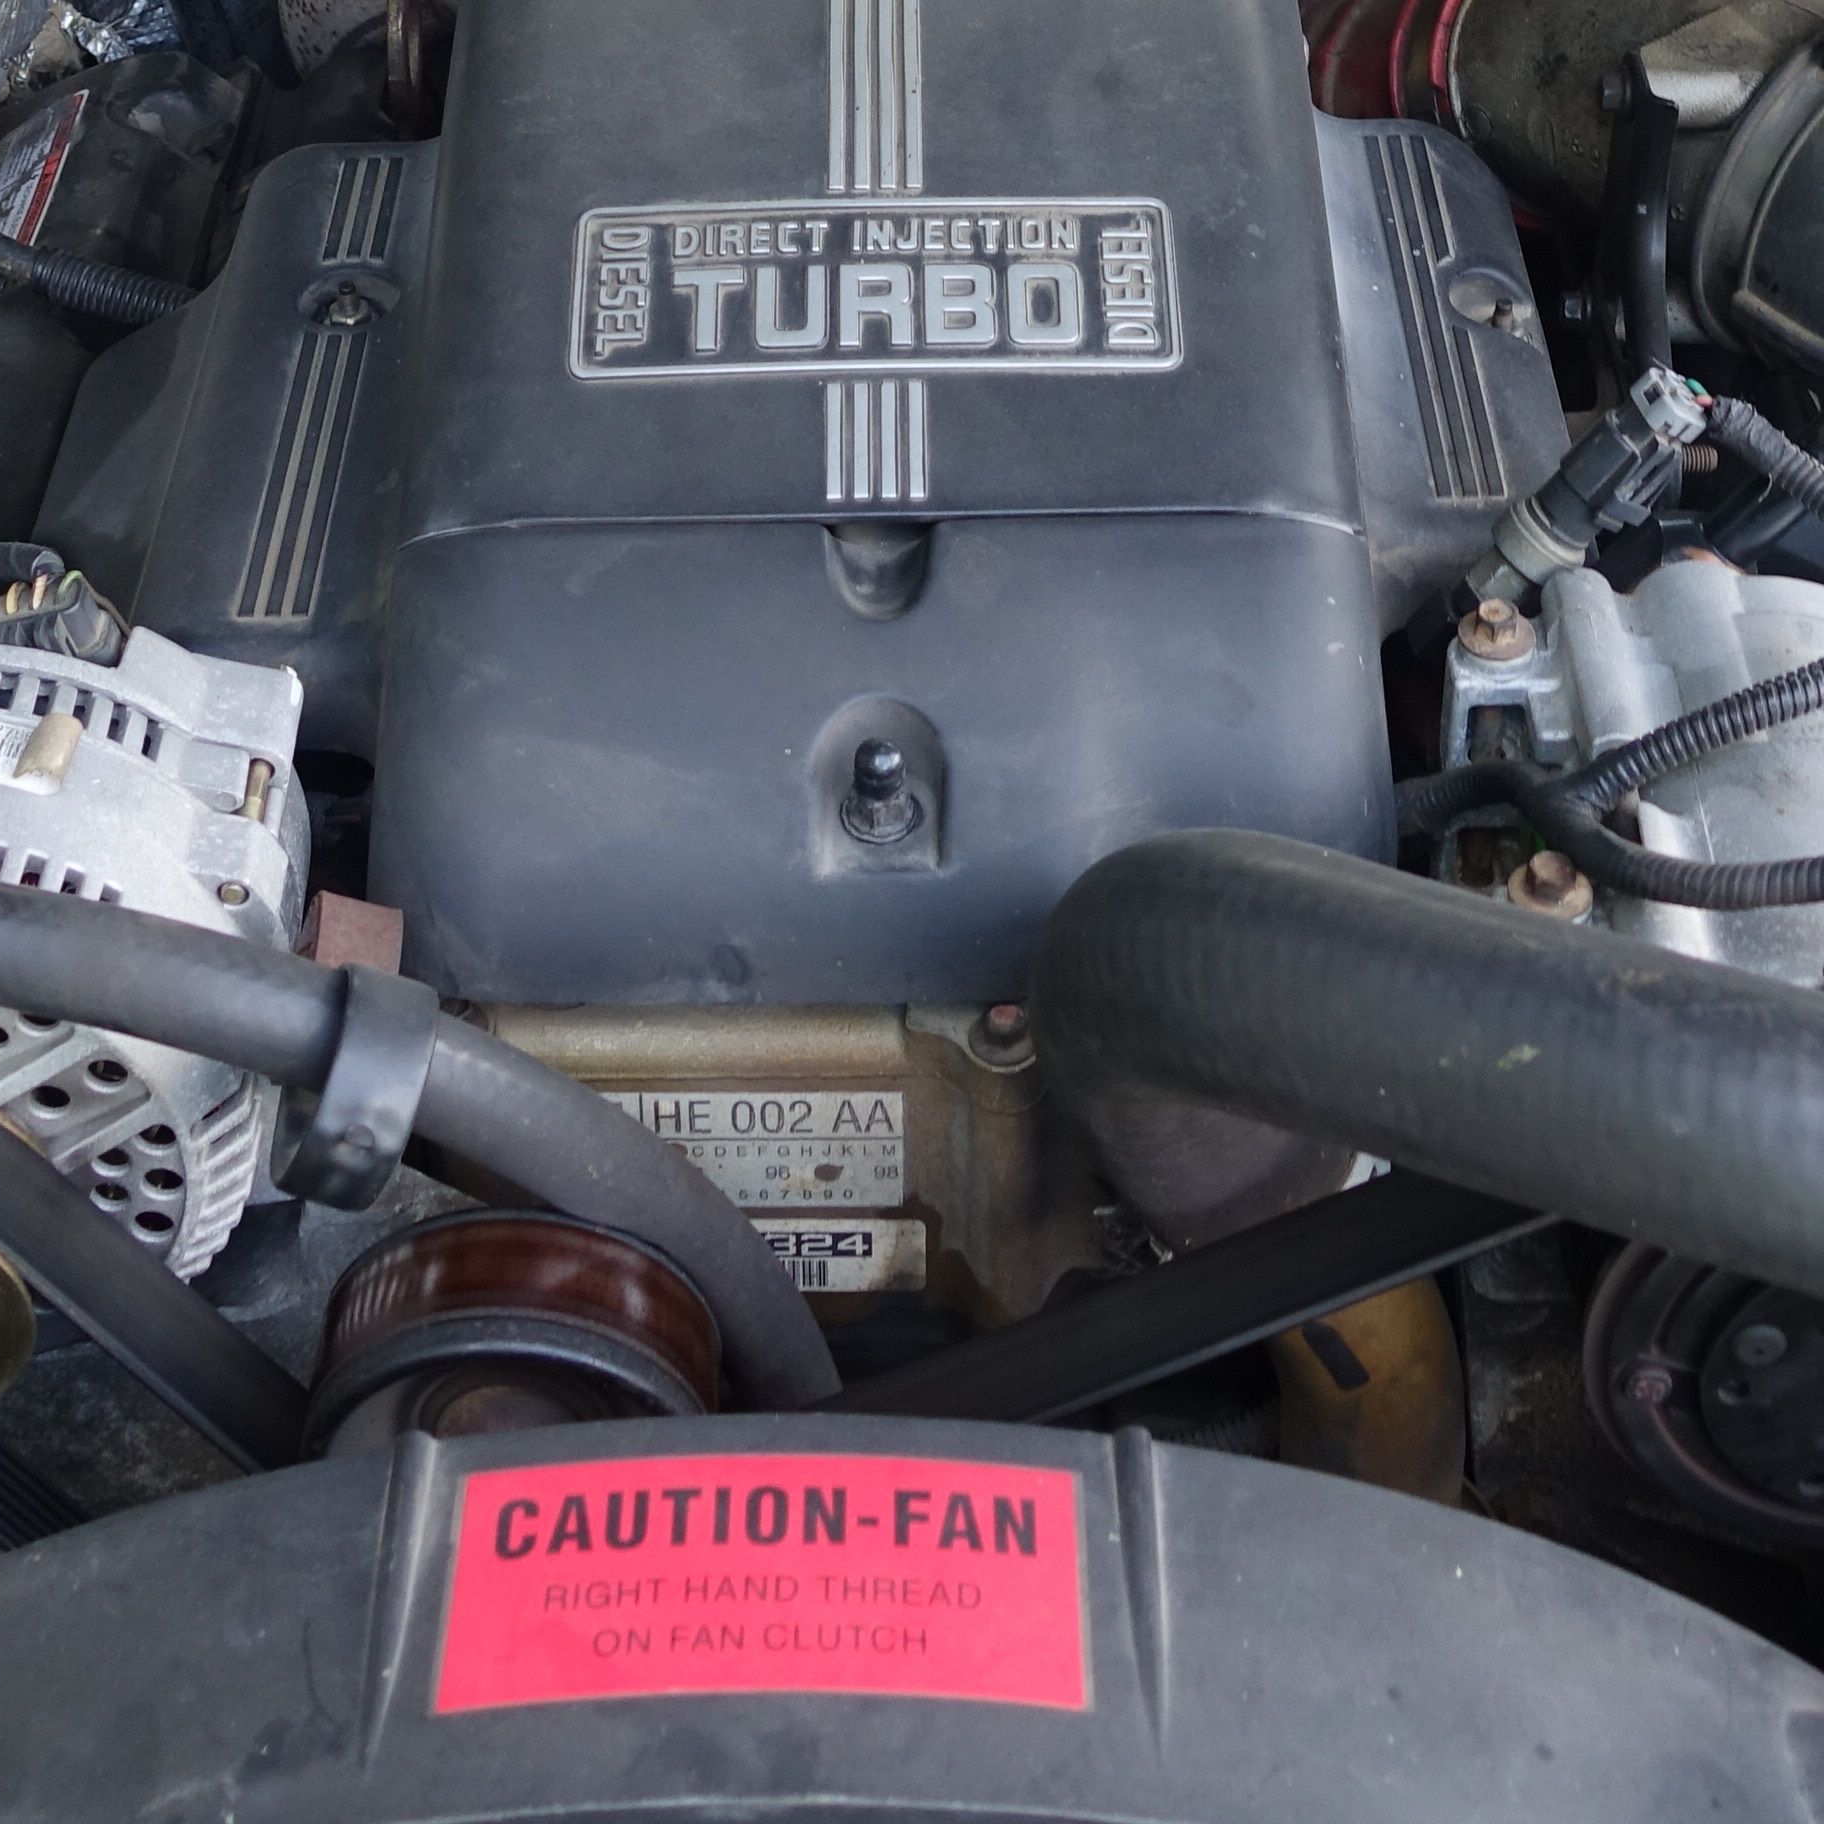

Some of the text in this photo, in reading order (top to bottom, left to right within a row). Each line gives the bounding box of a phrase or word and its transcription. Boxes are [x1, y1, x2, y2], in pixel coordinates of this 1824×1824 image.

[671, 218, 1077, 258] DIRECT INJECTION
[594, 225, 651, 357] DIESEL
[671, 262, 1080, 352] TURBO
[1101, 217, 1157, 348] DIESEL
[653, 1099, 894, 1135] HE 002 AA
[493, 1485, 1039, 1561] CAUTION-FAN
[542, 1574, 984, 1612] RIGHT HAND THREAD
[592, 1624, 927, 1657] ON FAN CLUTCH
